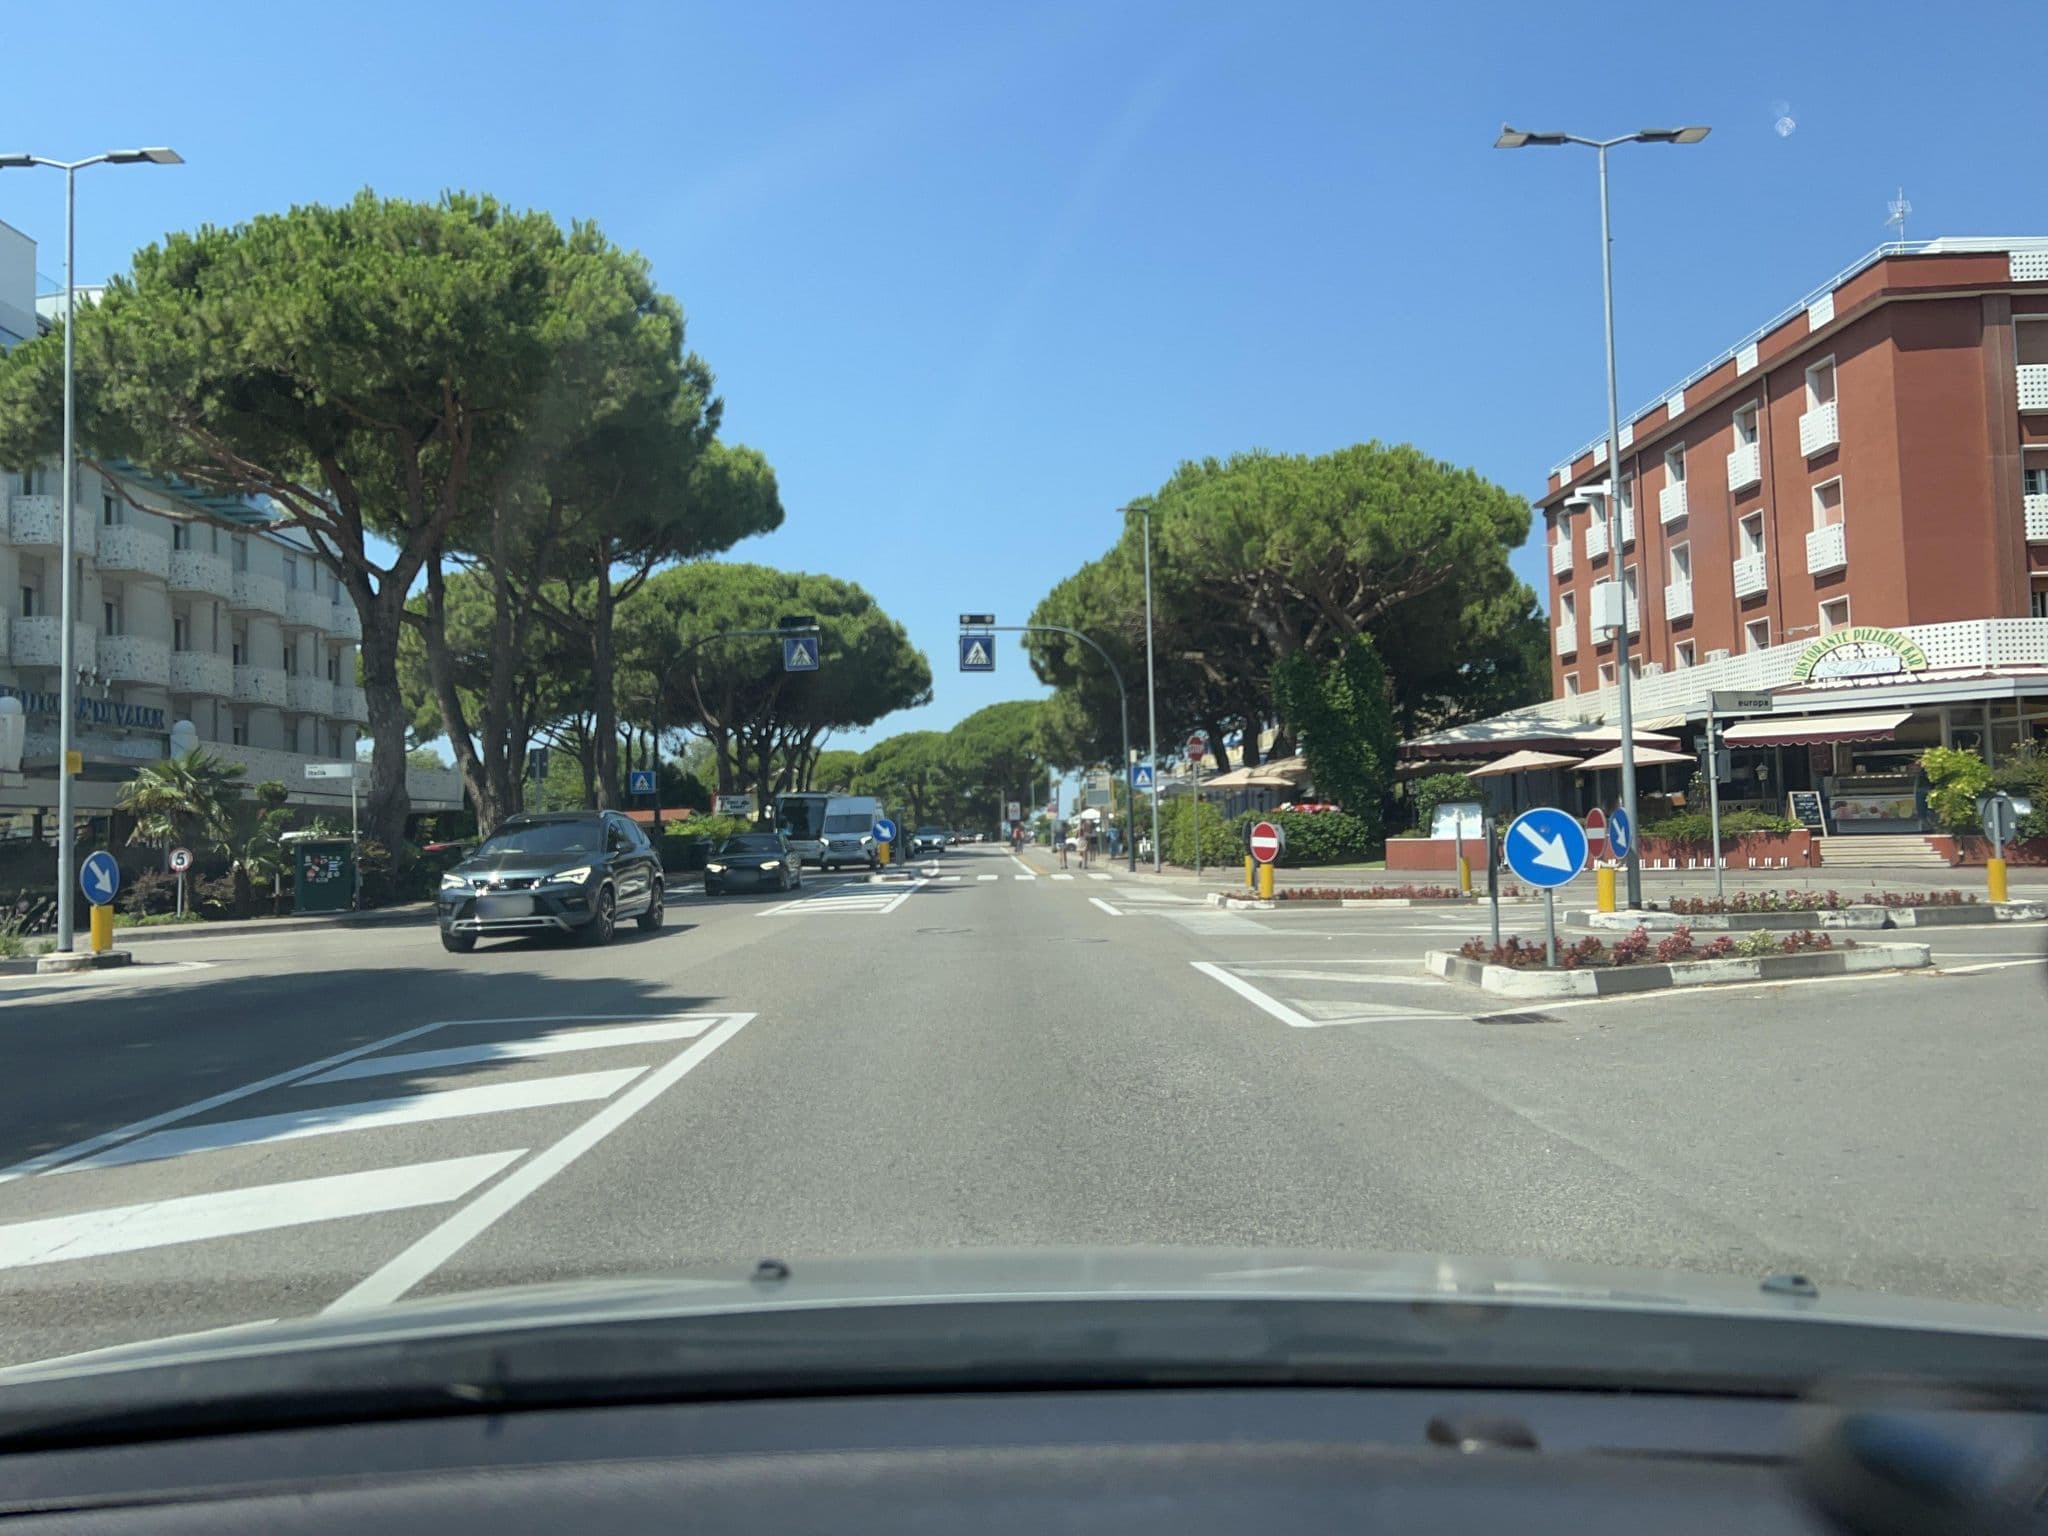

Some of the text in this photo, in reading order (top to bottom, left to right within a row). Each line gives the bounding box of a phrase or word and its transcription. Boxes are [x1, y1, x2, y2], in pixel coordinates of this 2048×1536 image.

[1793, 631, 1848, 677] RISTORANTE
[1853, 628, 1901, 651] PIZZERIA
[1901, 646, 1923, 667] BAR
[1738, 699, 1769, 708] europa
[175, 851, 186, 866] 5
